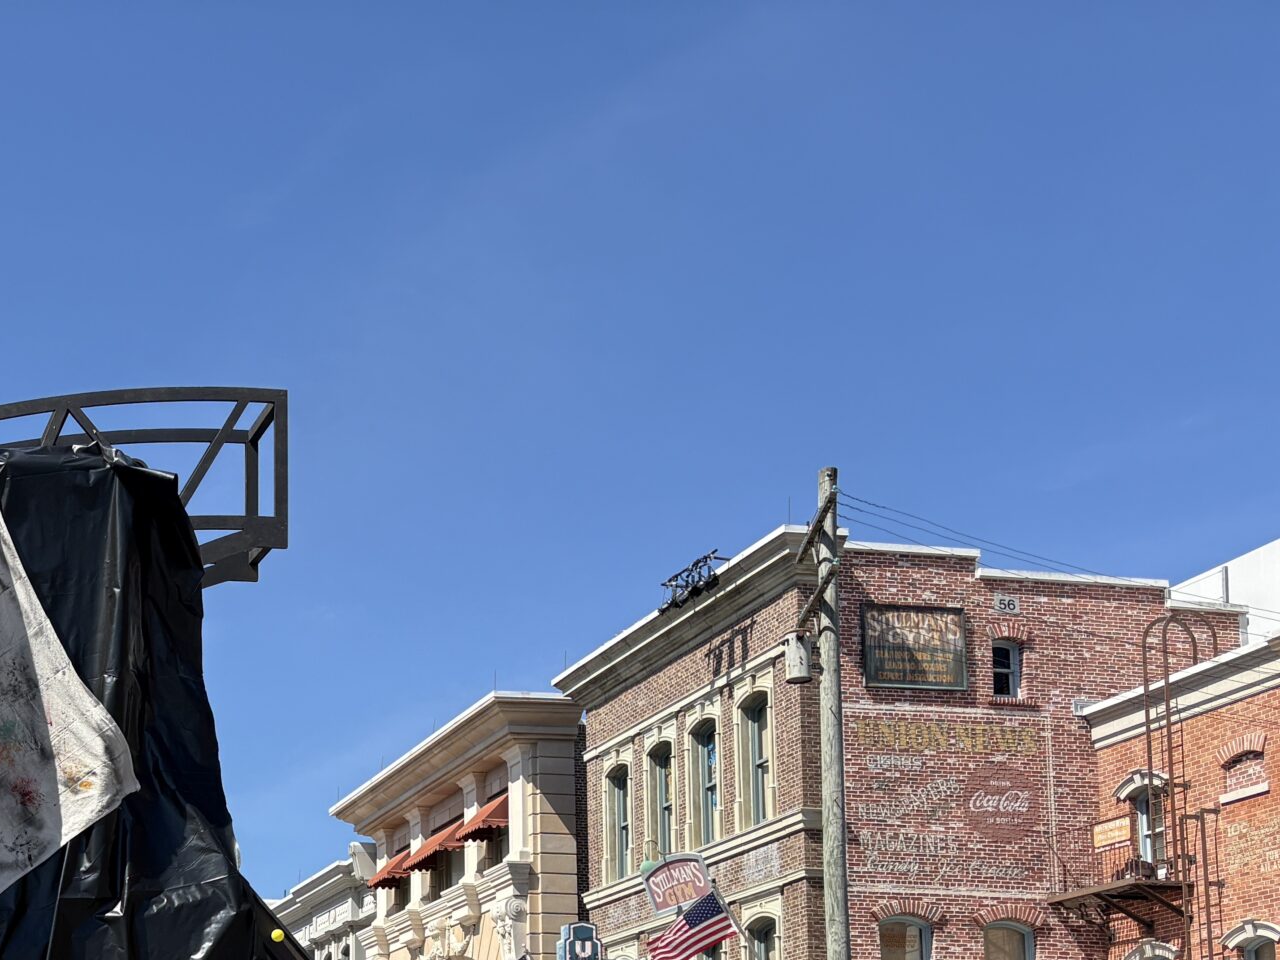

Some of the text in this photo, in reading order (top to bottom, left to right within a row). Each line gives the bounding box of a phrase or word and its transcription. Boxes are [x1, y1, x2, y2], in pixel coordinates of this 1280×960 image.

[998, 599, 1017, 611] 56
[854, 719, 1038, 755] UNION NEWS
[858, 831, 959, 854] MAGAZINES
[649, 861, 705, 903] STILLMAN'S
[665, 882, 697, 906] GYM
